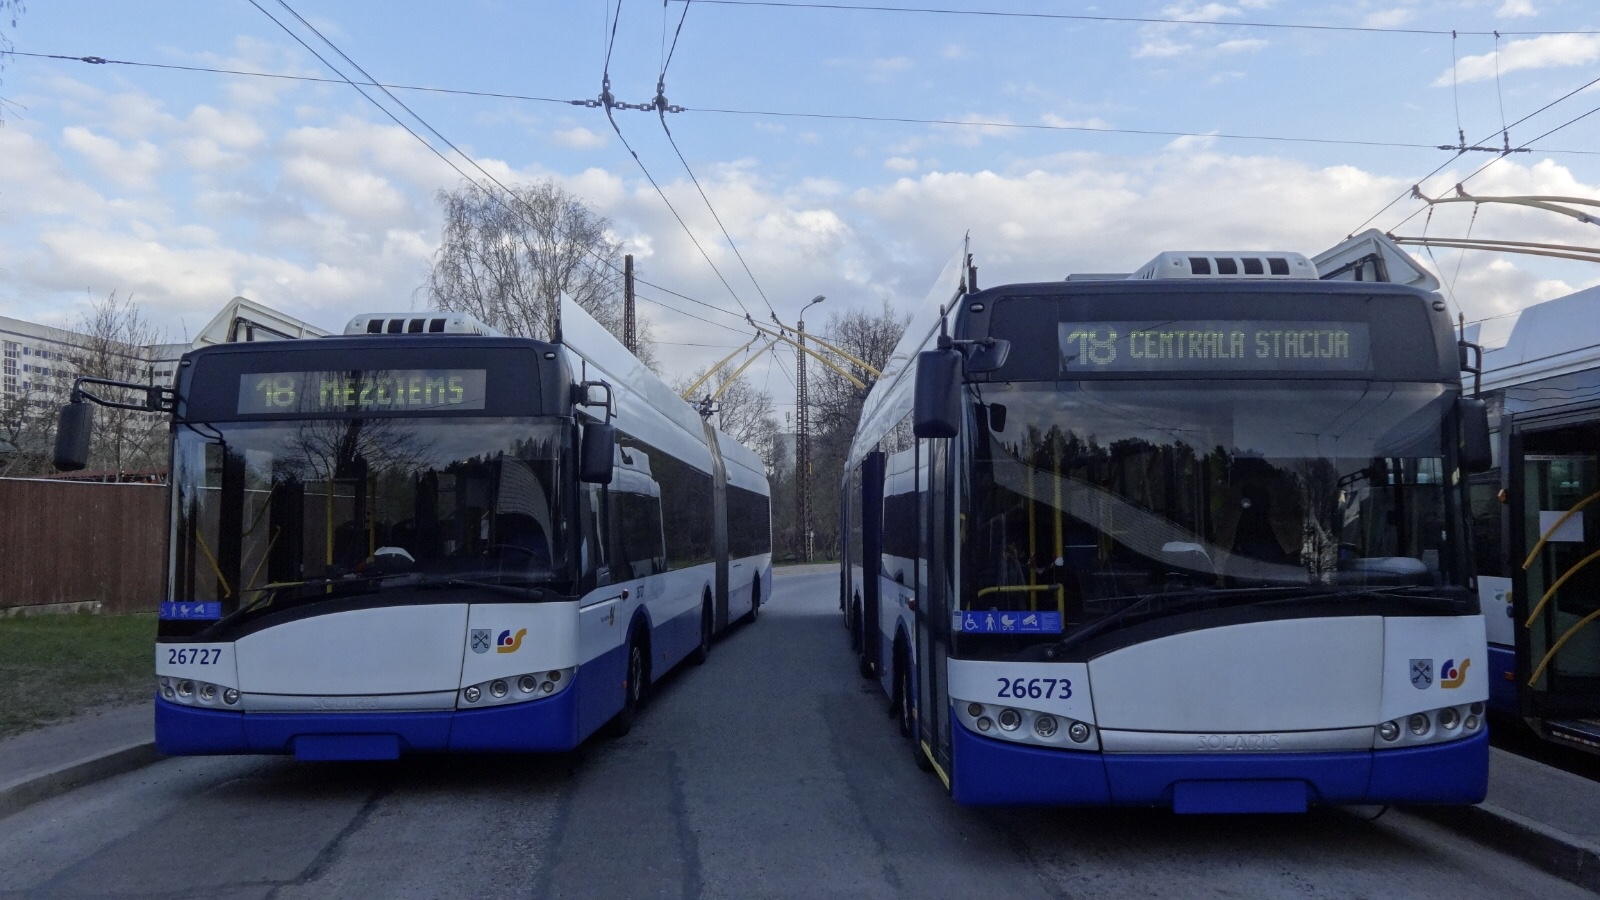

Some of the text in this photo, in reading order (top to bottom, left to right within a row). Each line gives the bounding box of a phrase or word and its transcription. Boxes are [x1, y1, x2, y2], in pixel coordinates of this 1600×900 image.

[1066, 329, 1118, 365] 18
[1255, 330, 1349, 358] STACIJA
[256, 375, 296, 407] 18
[168, 648, 222, 665] 26727
[997, 677, 1073, 700] 26673
[1197, 734, 1280, 751] SOLARIS
